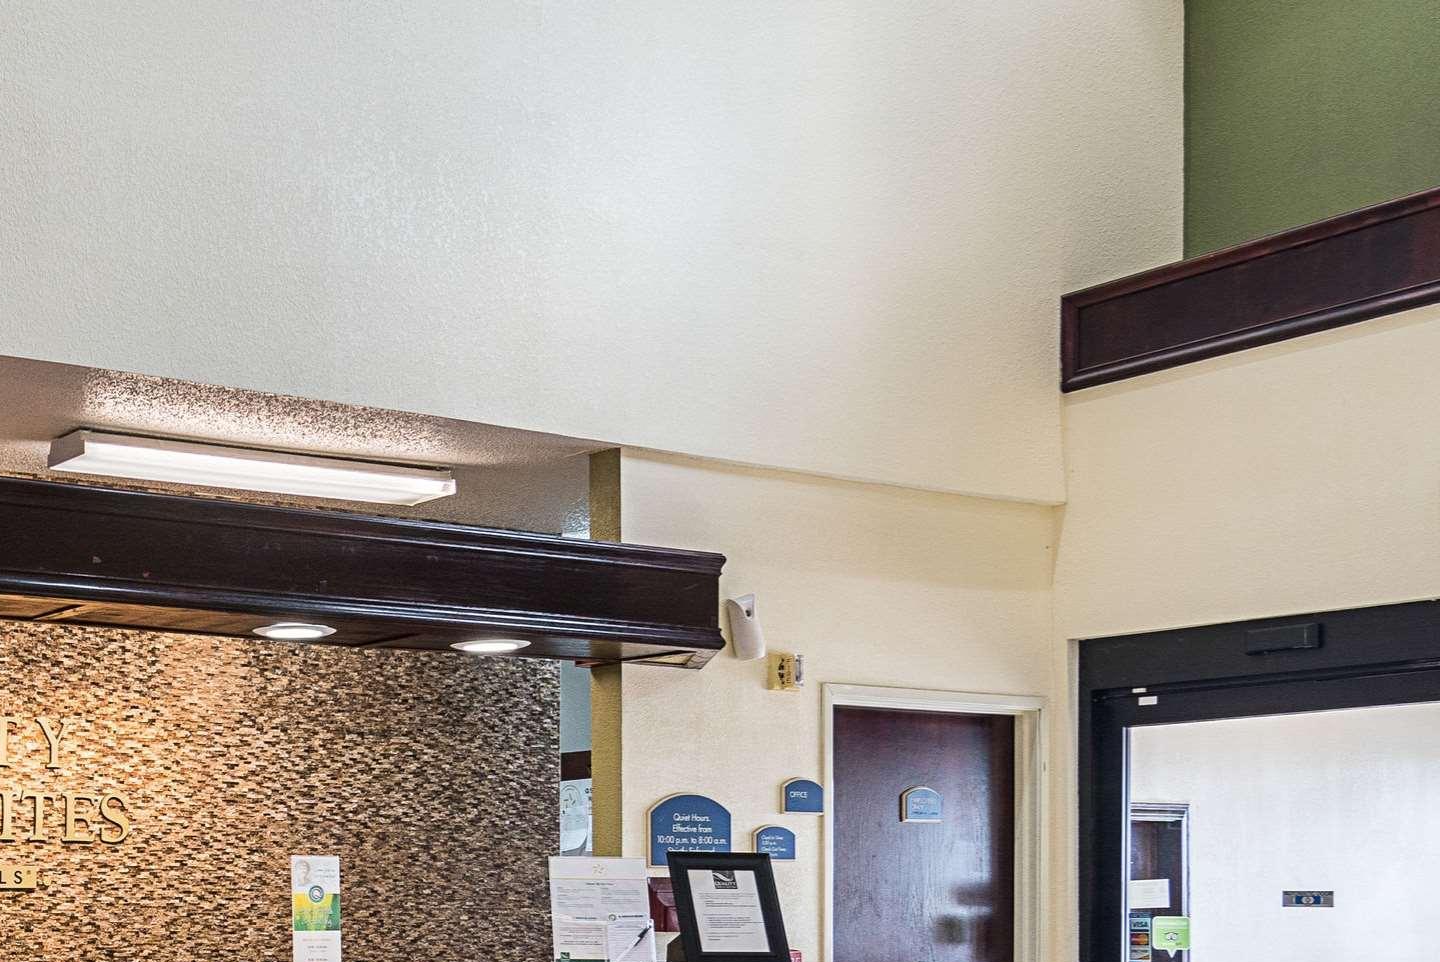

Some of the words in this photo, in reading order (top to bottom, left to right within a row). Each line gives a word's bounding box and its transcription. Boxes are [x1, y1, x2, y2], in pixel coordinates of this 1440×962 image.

[673, 812, 691, 822] Quiet
[672, 824, 698, 833] Effective
[656, 835, 675, 844] 10:00
[698, 836, 713, 845] 8:00
